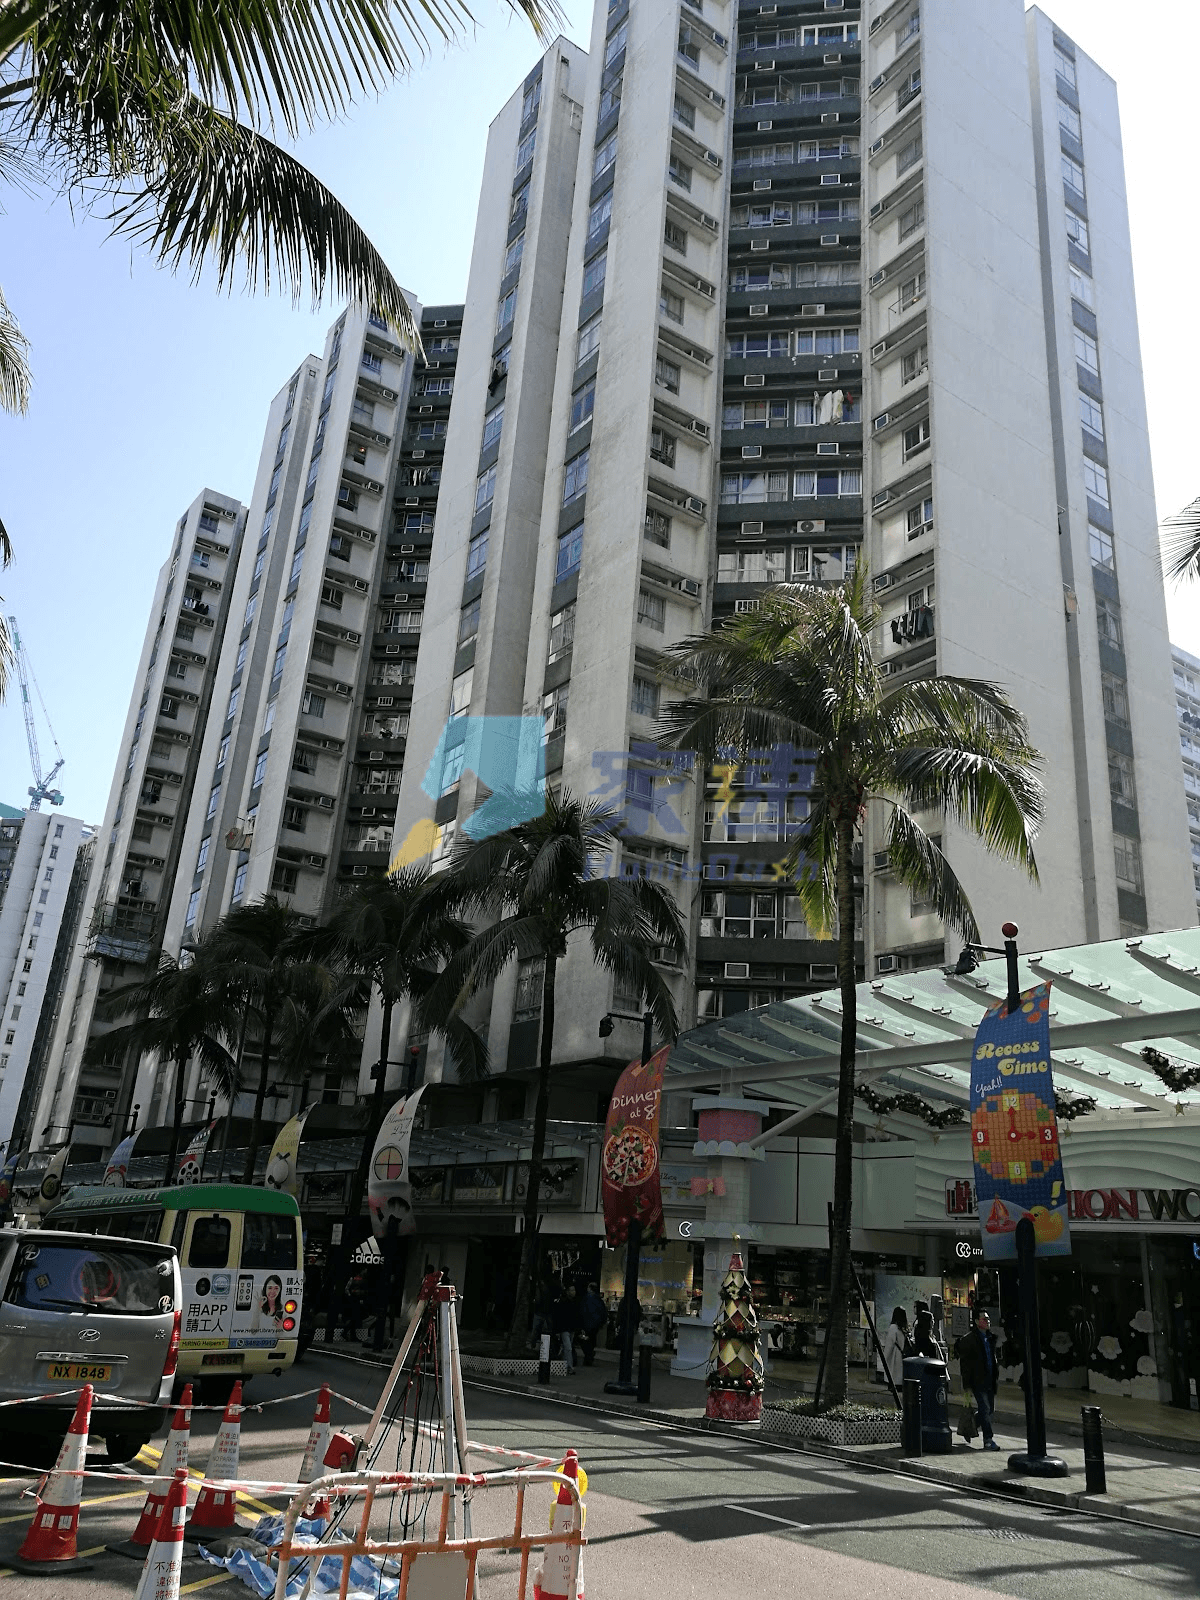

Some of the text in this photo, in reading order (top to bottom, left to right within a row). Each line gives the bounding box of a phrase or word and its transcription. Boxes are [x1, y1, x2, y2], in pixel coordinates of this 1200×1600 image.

[976, 1041, 1039, 1060] Recess
[998, 1058, 1048, 1076] Time
[975, 1076, 1003, 1098] Yeah!!
[612, 1089, 661, 1109] Dinner
[1005, 1097, 1018, 1107] 12
[630, 1104, 657, 1120] at 8
[977, 1131, 984, 1143] 9
[1044, 1128, 1053, 1141] 3
[1014, 1164, 1022, 1176] 6
[187, 1303, 228, 1317] 用APP
[186, 1318, 224, 1332] 請工人
[53, 1366, 106, 1380] NX 1848
[558, 1554, 570, 1563] NO
